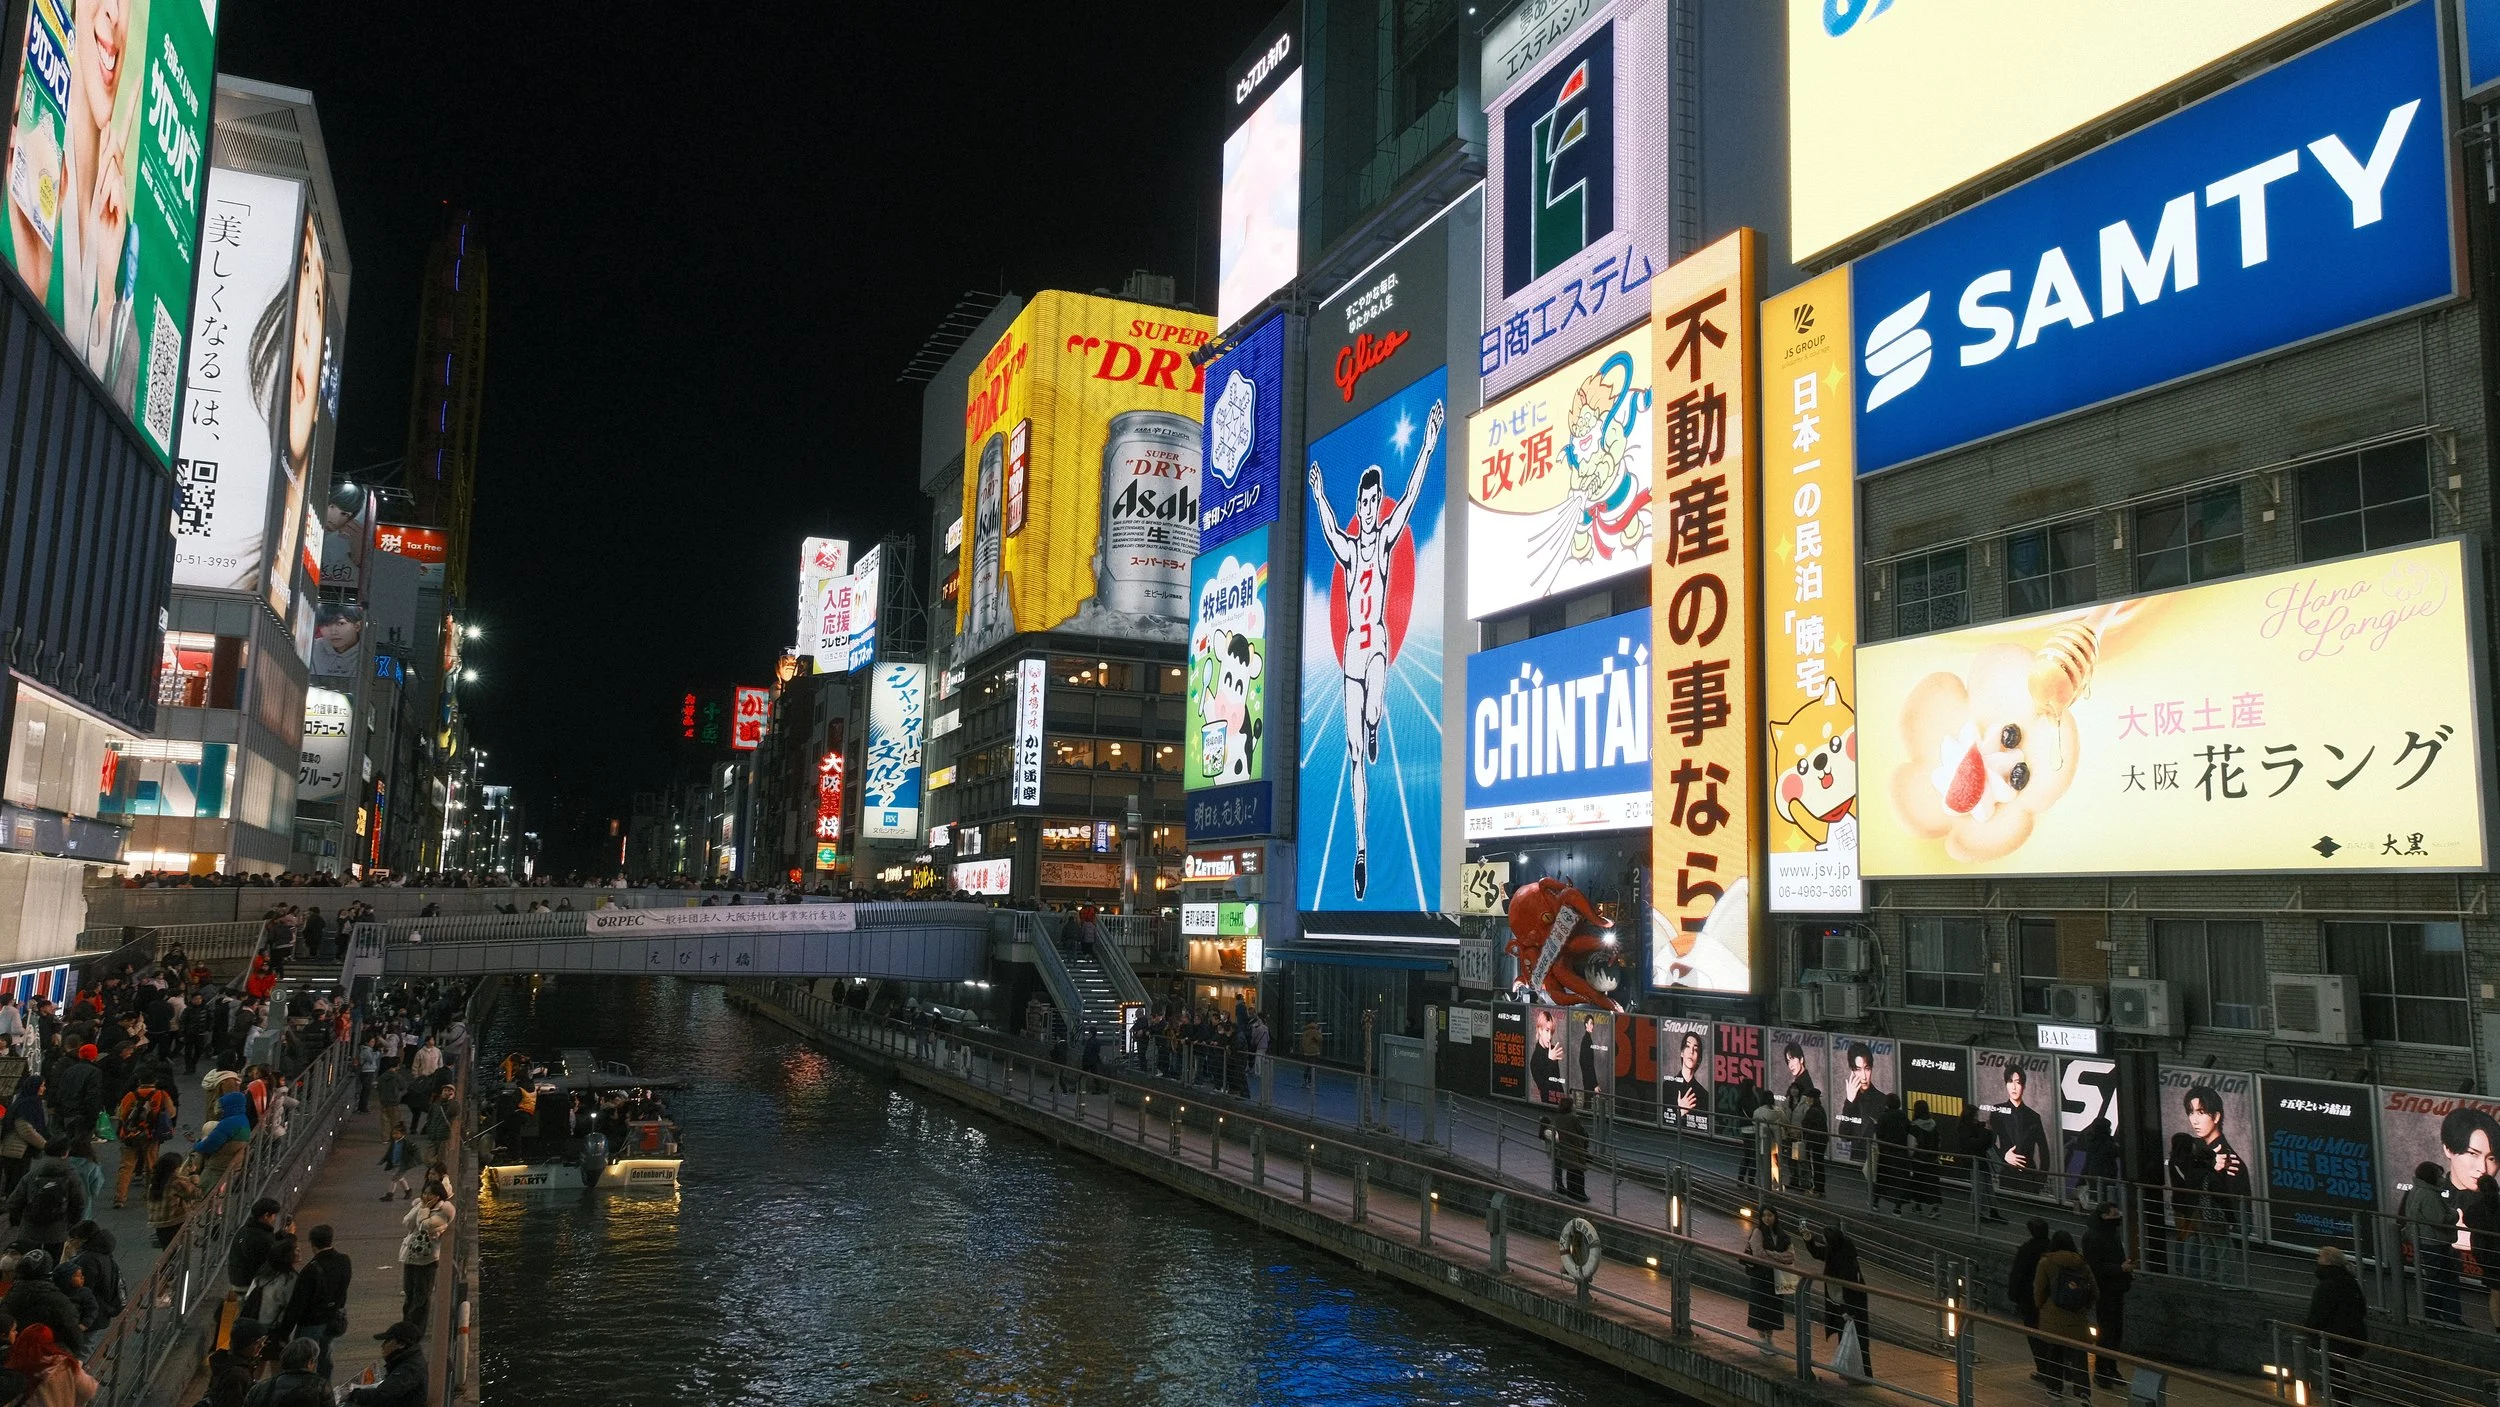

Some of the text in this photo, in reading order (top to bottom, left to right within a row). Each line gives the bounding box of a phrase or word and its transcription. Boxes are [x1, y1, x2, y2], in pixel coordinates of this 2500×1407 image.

[1236, 32, 1291, 106] ピップエレキバン
[149, 57, 200, 218] サロンパス
[1959, 98, 2421, 368] SAMTY
[187, 199, 251, 441] 「美しくなる」は、
[1479, 244, 1653, 379] 日商エステム
[1129, 319, 1210, 348] SUPER
[1784, 335, 1826, 360] JS GROUP
[1334, 327, 1412, 402] Glico
[1487, 398, 1549, 448] かぜに
[1145, 449, 1180, 461] SUPER
[1481, 424, 1555, 501] 改源
[1202, 485, 1260, 532] 雪印メグミルク
[380, 533, 403, 554] 税
[406, 541, 443, 552] Tax Free
[1147, 526, 1171, 545] 生
[1130, 557, 1186, 571] スーパードライ
[824, 586, 852, 612] 入店
[1203, 575, 1254, 624] 牧場の朝
[1359, 565, 1373, 652] グリコ
[1665, 291, 1732, 930] 不動産の事なら
[2259, 578, 2373, 642] Hana
[822, 610, 851, 635] 応援
[2297, 599, 2438, 663] Langue
[1027, 682, 1040, 730] 本場の味
[2117, 692, 2267, 741] 大阪土産
[1023, 734, 1040, 801] かに道楽
[2121, 724, 2455, 803] 大阪 花ラング
[885, 814, 897, 823] BX
[2380, 832, 2429, 856] 大黒
[1194, 859, 1236, 877] ZETTERIA
[1780, 863, 1851, 881] www.jsv.jp
[1469, 869, 1500, 908] くくる
[1778, 885, 1853, 899] 06-4963-3661
[1663, 1019, 1687, 1034] Snow
[1720, 1024, 1759, 1057] THE
[2040, 1029, 2070, 1046] BAR
[1494, 1041, 1525, 1055] THE BEST
[1714, 1054, 1765, 1088] BEST
[1696, 1115, 1708, 1124] BEST
[2280, 1098, 2352, 1117] #五年という結晶
[2385, 1092, 2454, 1117] Snow
[2270, 1129, 2369, 1158] Snow Man
[513, 1176, 549, 1186] PARTY
[2271, 1151, 2371, 1182] THE BEST
